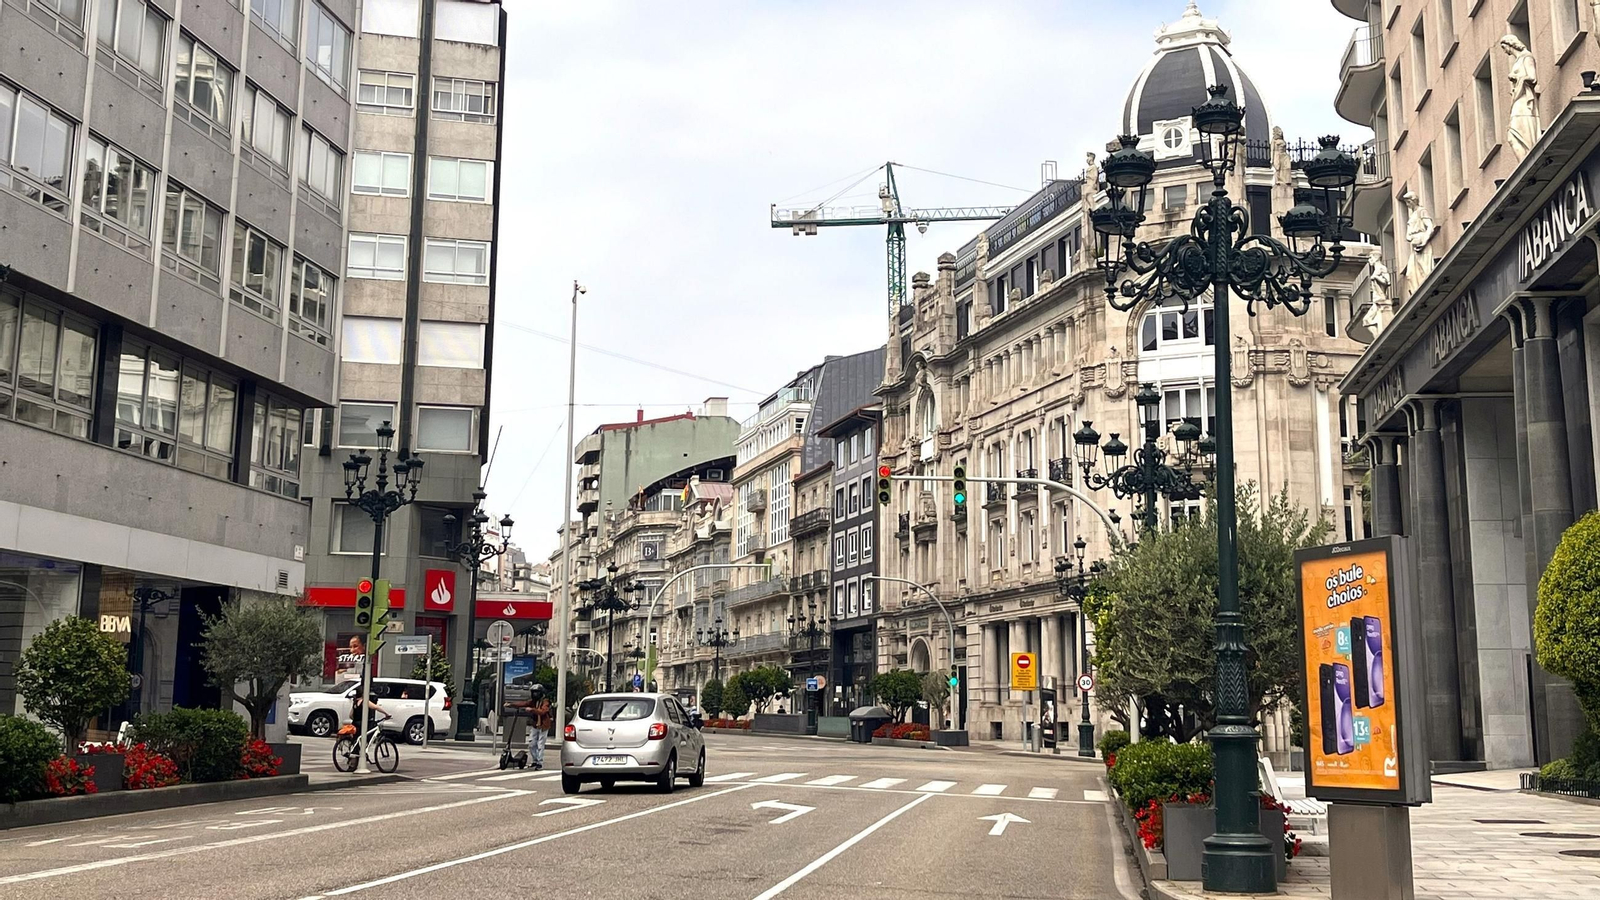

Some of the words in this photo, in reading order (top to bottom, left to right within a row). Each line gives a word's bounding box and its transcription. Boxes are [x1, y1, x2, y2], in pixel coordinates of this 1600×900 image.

[1519, 171, 1591, 281] ABANCA
[1431, 290, 1479, 368] ABANCA
[1326, 575, 1339, 590] os
[1339, 564, 1363, 586] bule
[100, 614, 131, 633] BBVA
[338, 653, 365, 662] START
